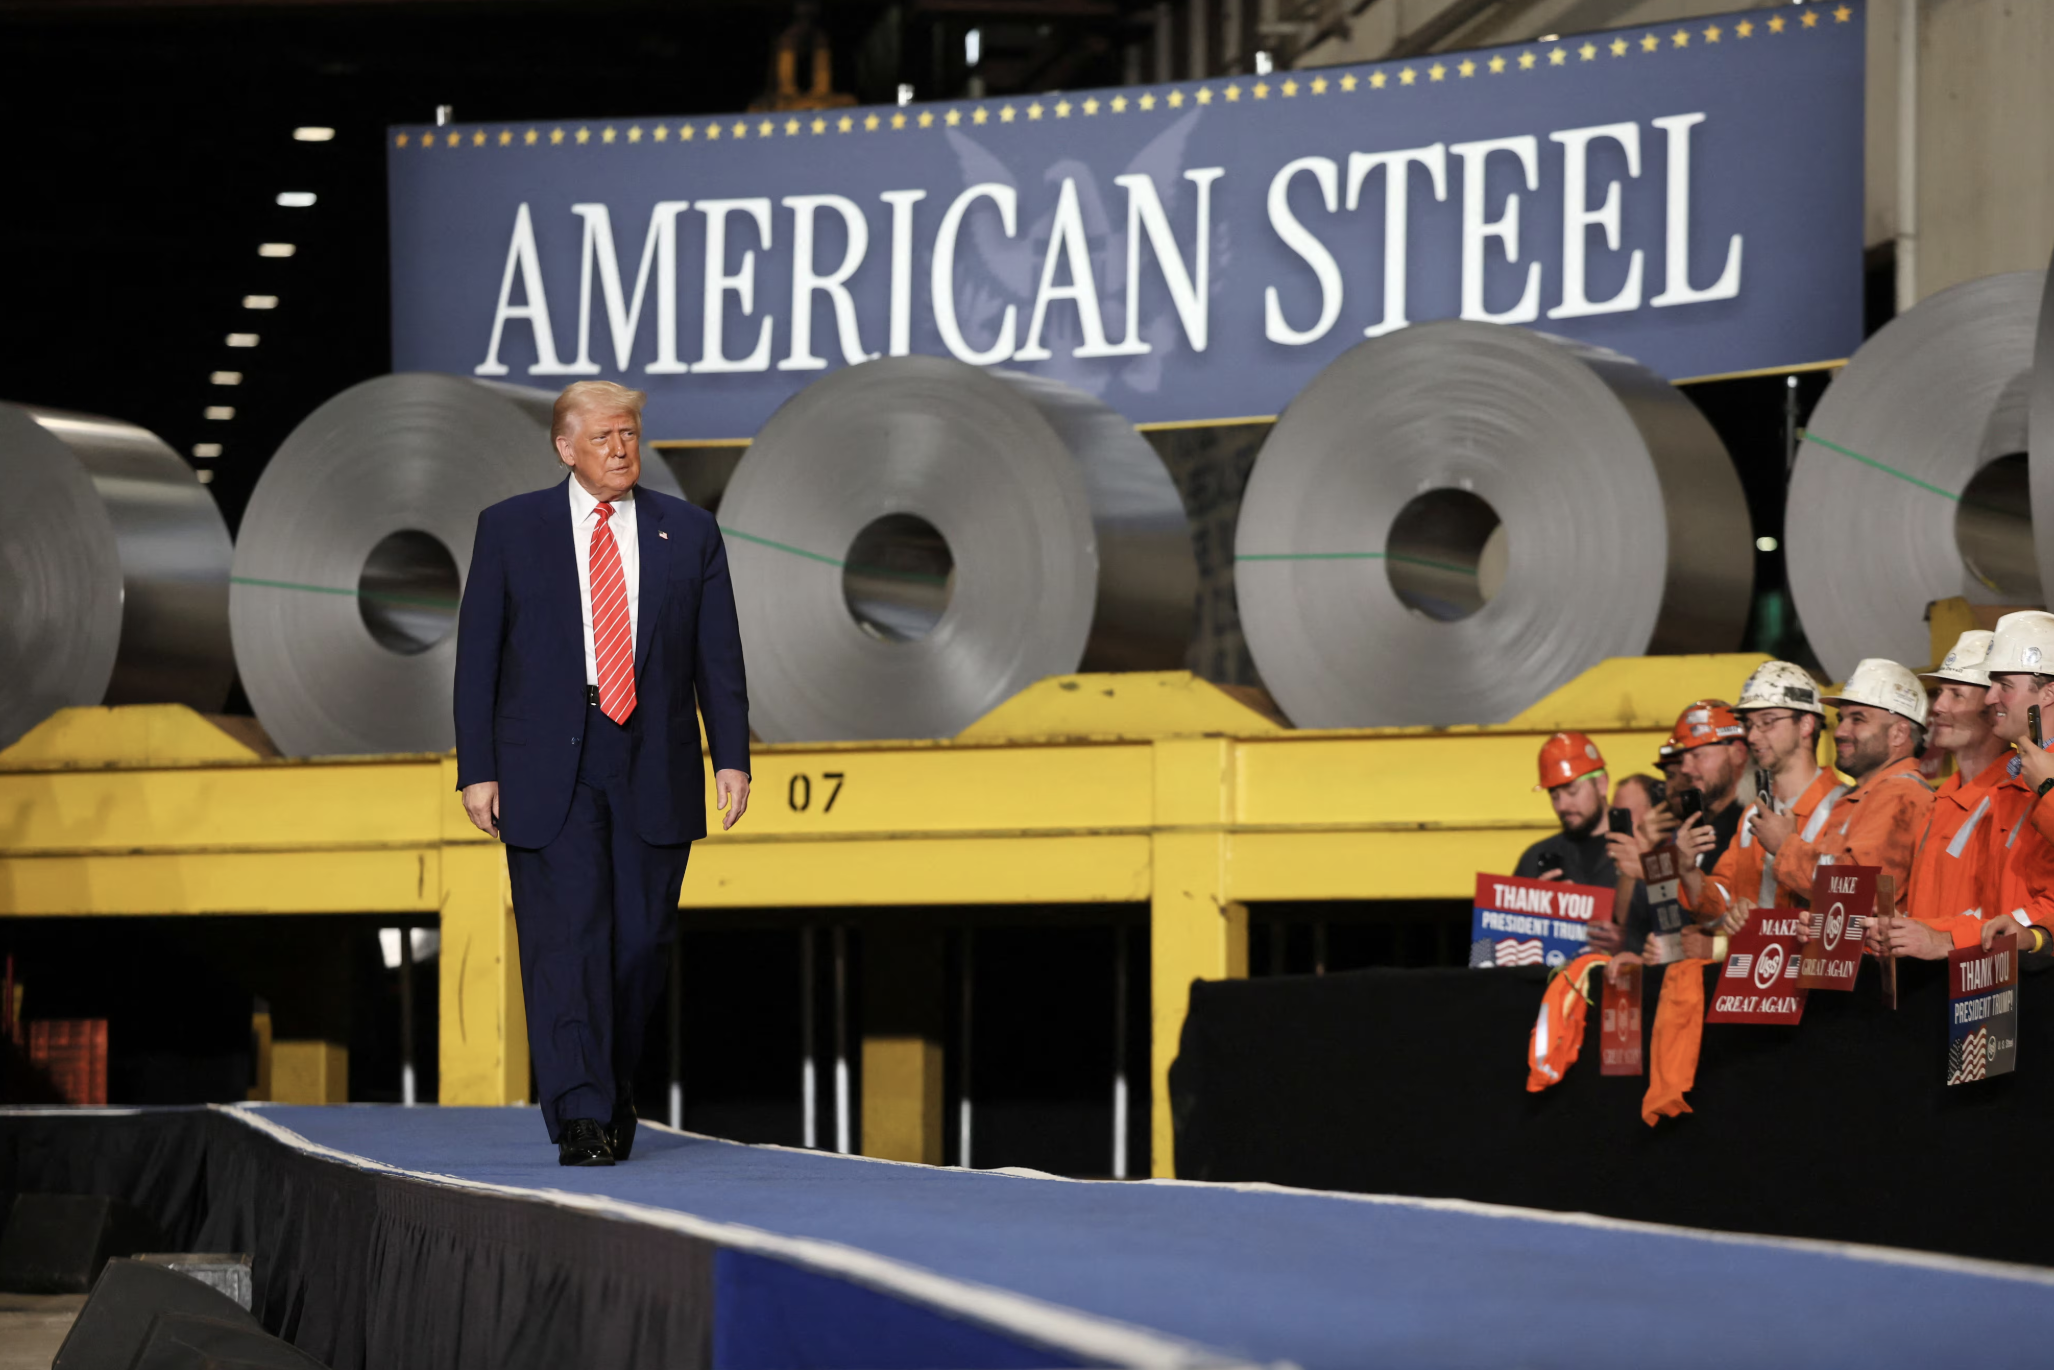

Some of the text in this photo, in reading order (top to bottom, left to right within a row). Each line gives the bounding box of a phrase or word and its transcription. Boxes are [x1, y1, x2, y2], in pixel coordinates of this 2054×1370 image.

[475, 112, 1742, 374] AMERICAN STEEL
[787, 773, 845, 812] 07
[1828, 876, 1858, 894] MAKE
[1493, 883, 1595, 919] THANK YOU
[1482, 911, 1550, 937] PRESIDENT
[1759, 918, 1799, 936] MAKE
[1801, 959, 1855, 978] GREAT AGAIN
[1959, 950, 2010, 993] THANK YOU
[1715, 995, 1799, 1013] GREAT AGAIN
[1954, 996, 1992, 1025] PRESIDENT
